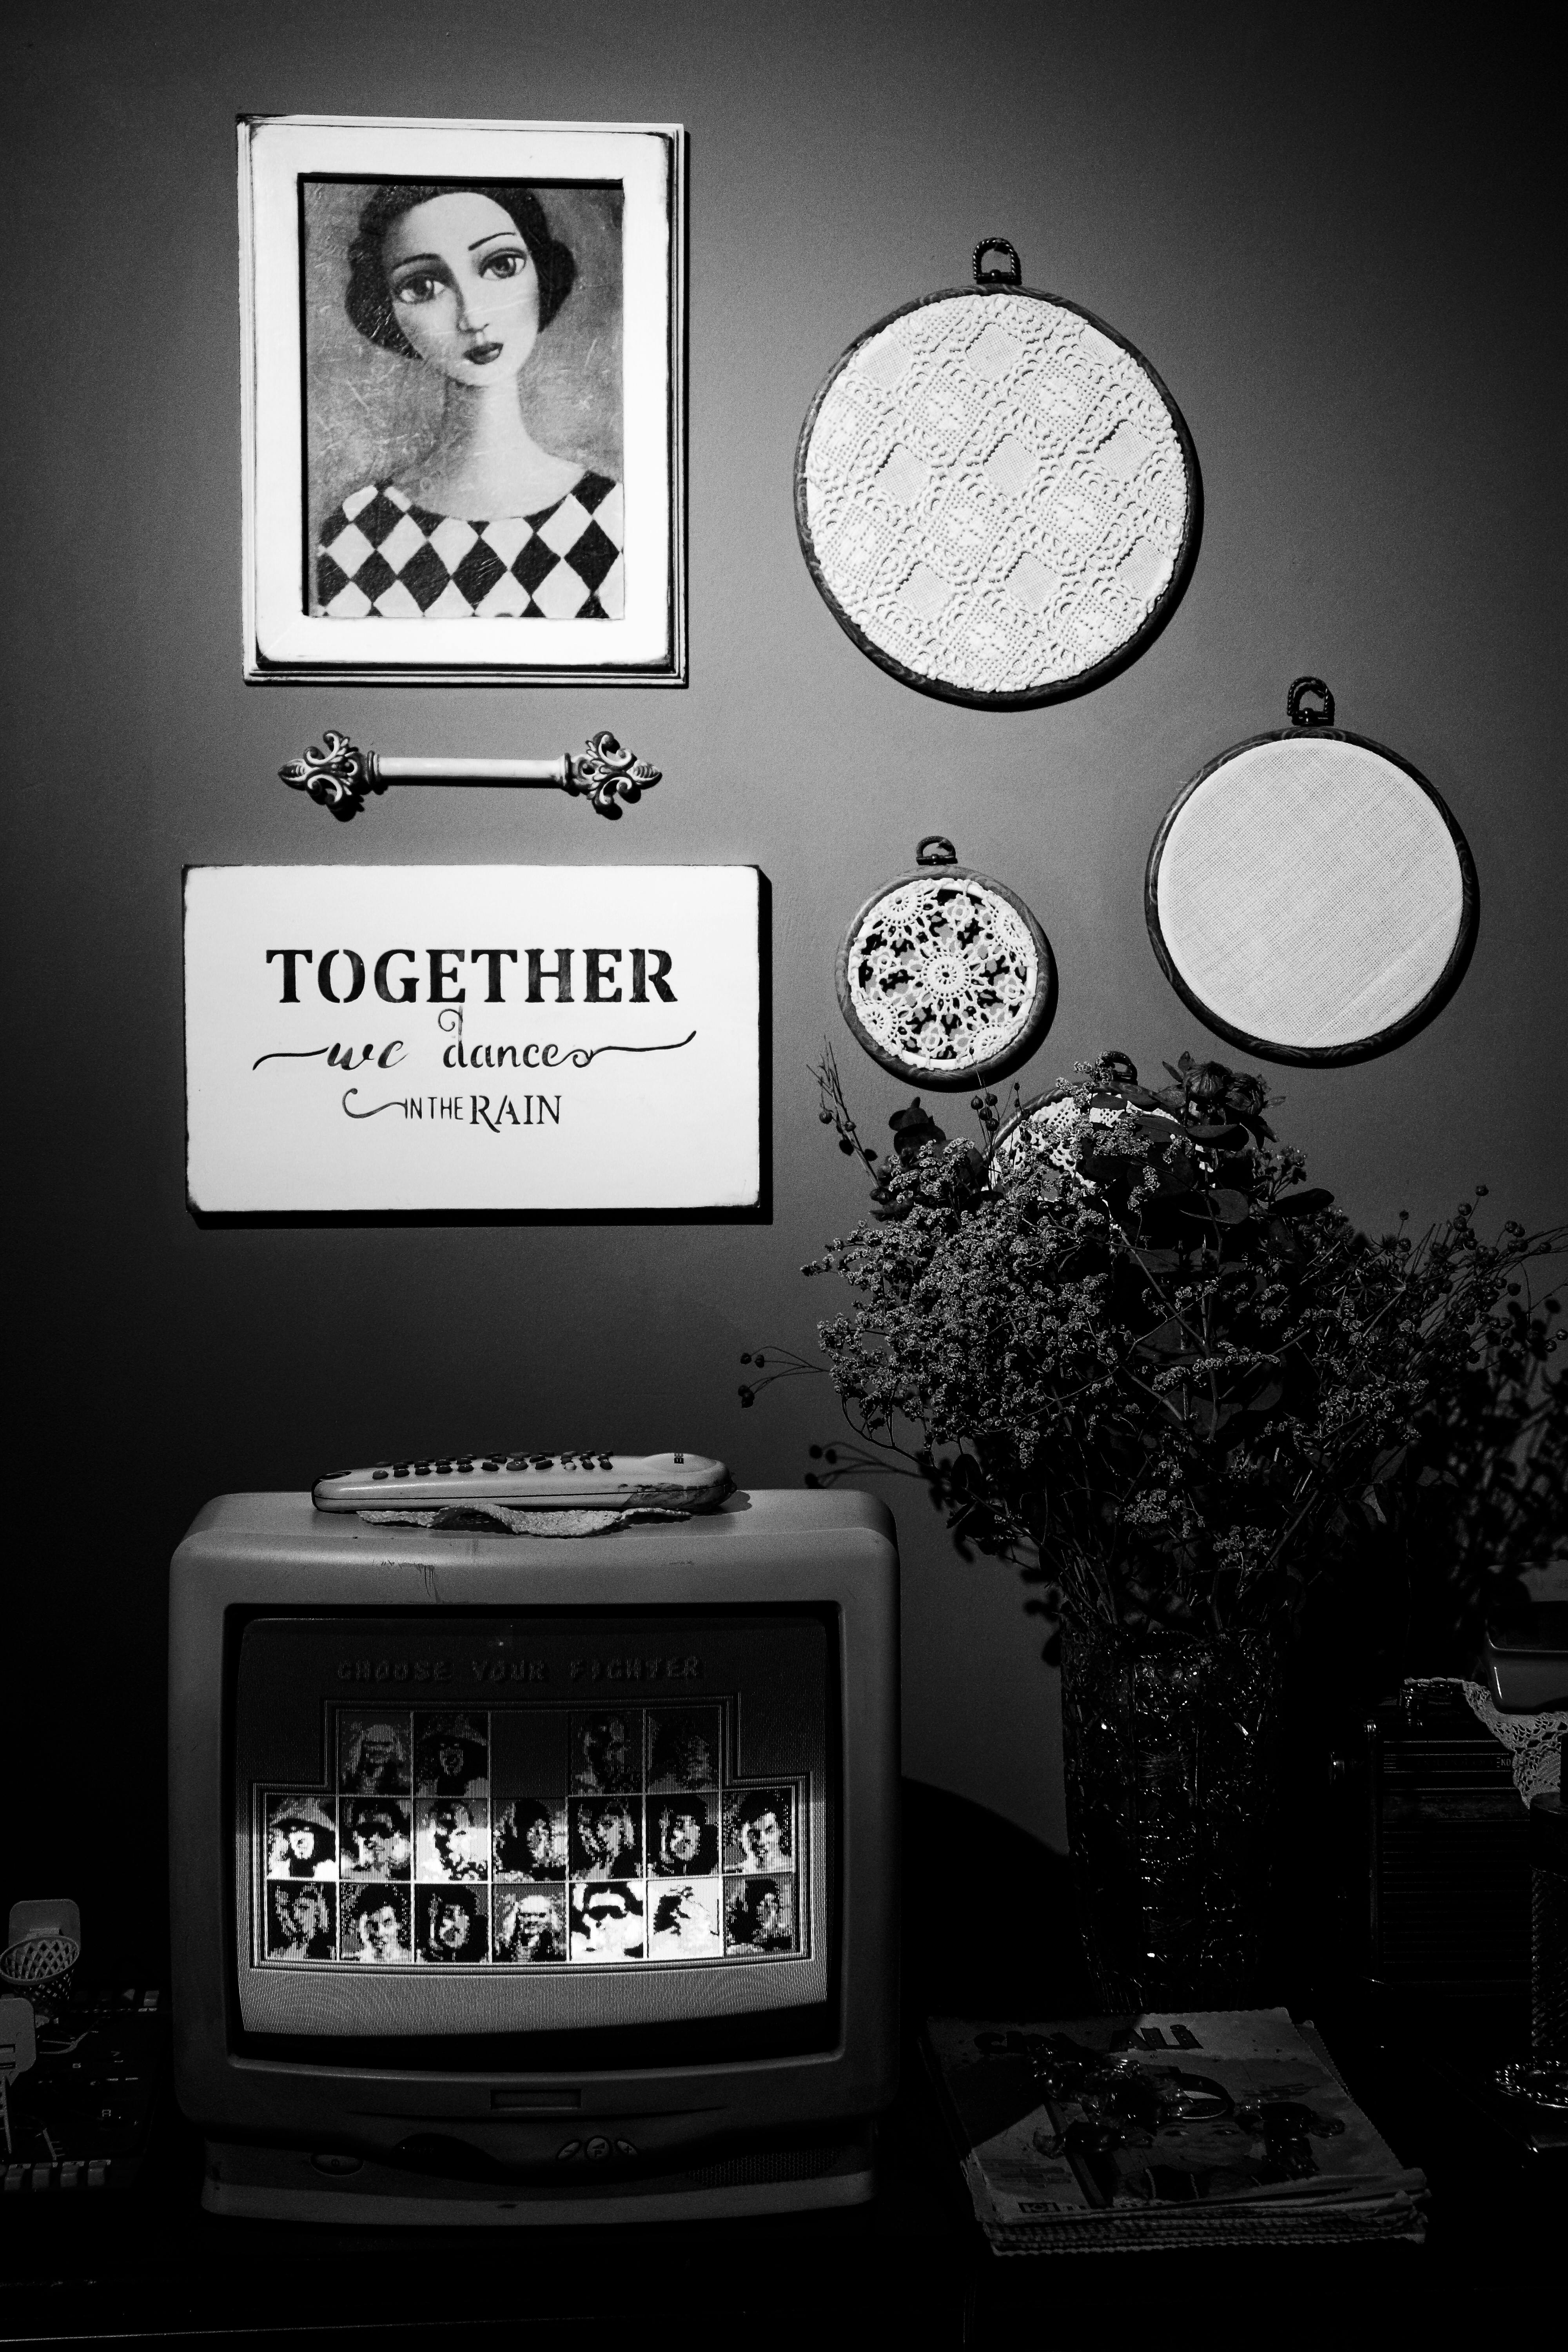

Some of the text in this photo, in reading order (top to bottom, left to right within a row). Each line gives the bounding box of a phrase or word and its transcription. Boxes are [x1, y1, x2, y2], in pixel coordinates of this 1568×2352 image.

[266, 949, 677, 1003] TOGETHER
[327, 1005, 596, 1070] we dance
[427, 1096, 464, 1120] THE
[469, 1095, 562, 1133] RAIN
[336, 1656, 702, 1682] CHOOSE YOUR FIGHTER
